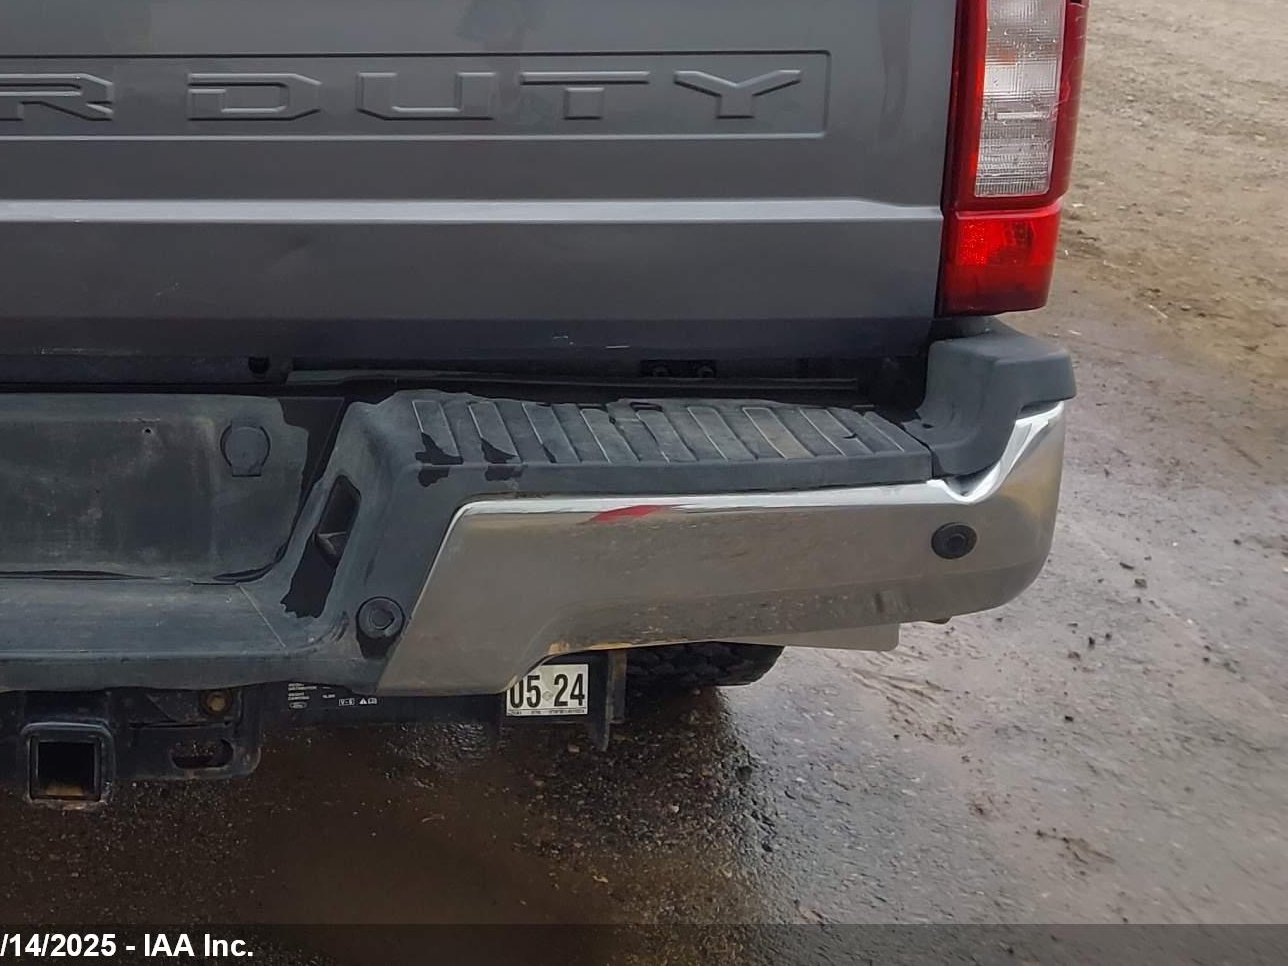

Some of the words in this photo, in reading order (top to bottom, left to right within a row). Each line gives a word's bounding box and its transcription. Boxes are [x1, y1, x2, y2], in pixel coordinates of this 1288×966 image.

[186, 70, 803, 120] DUTY
[510, 675, 541, 708] 05
[553, 674, 585, 707] 24
